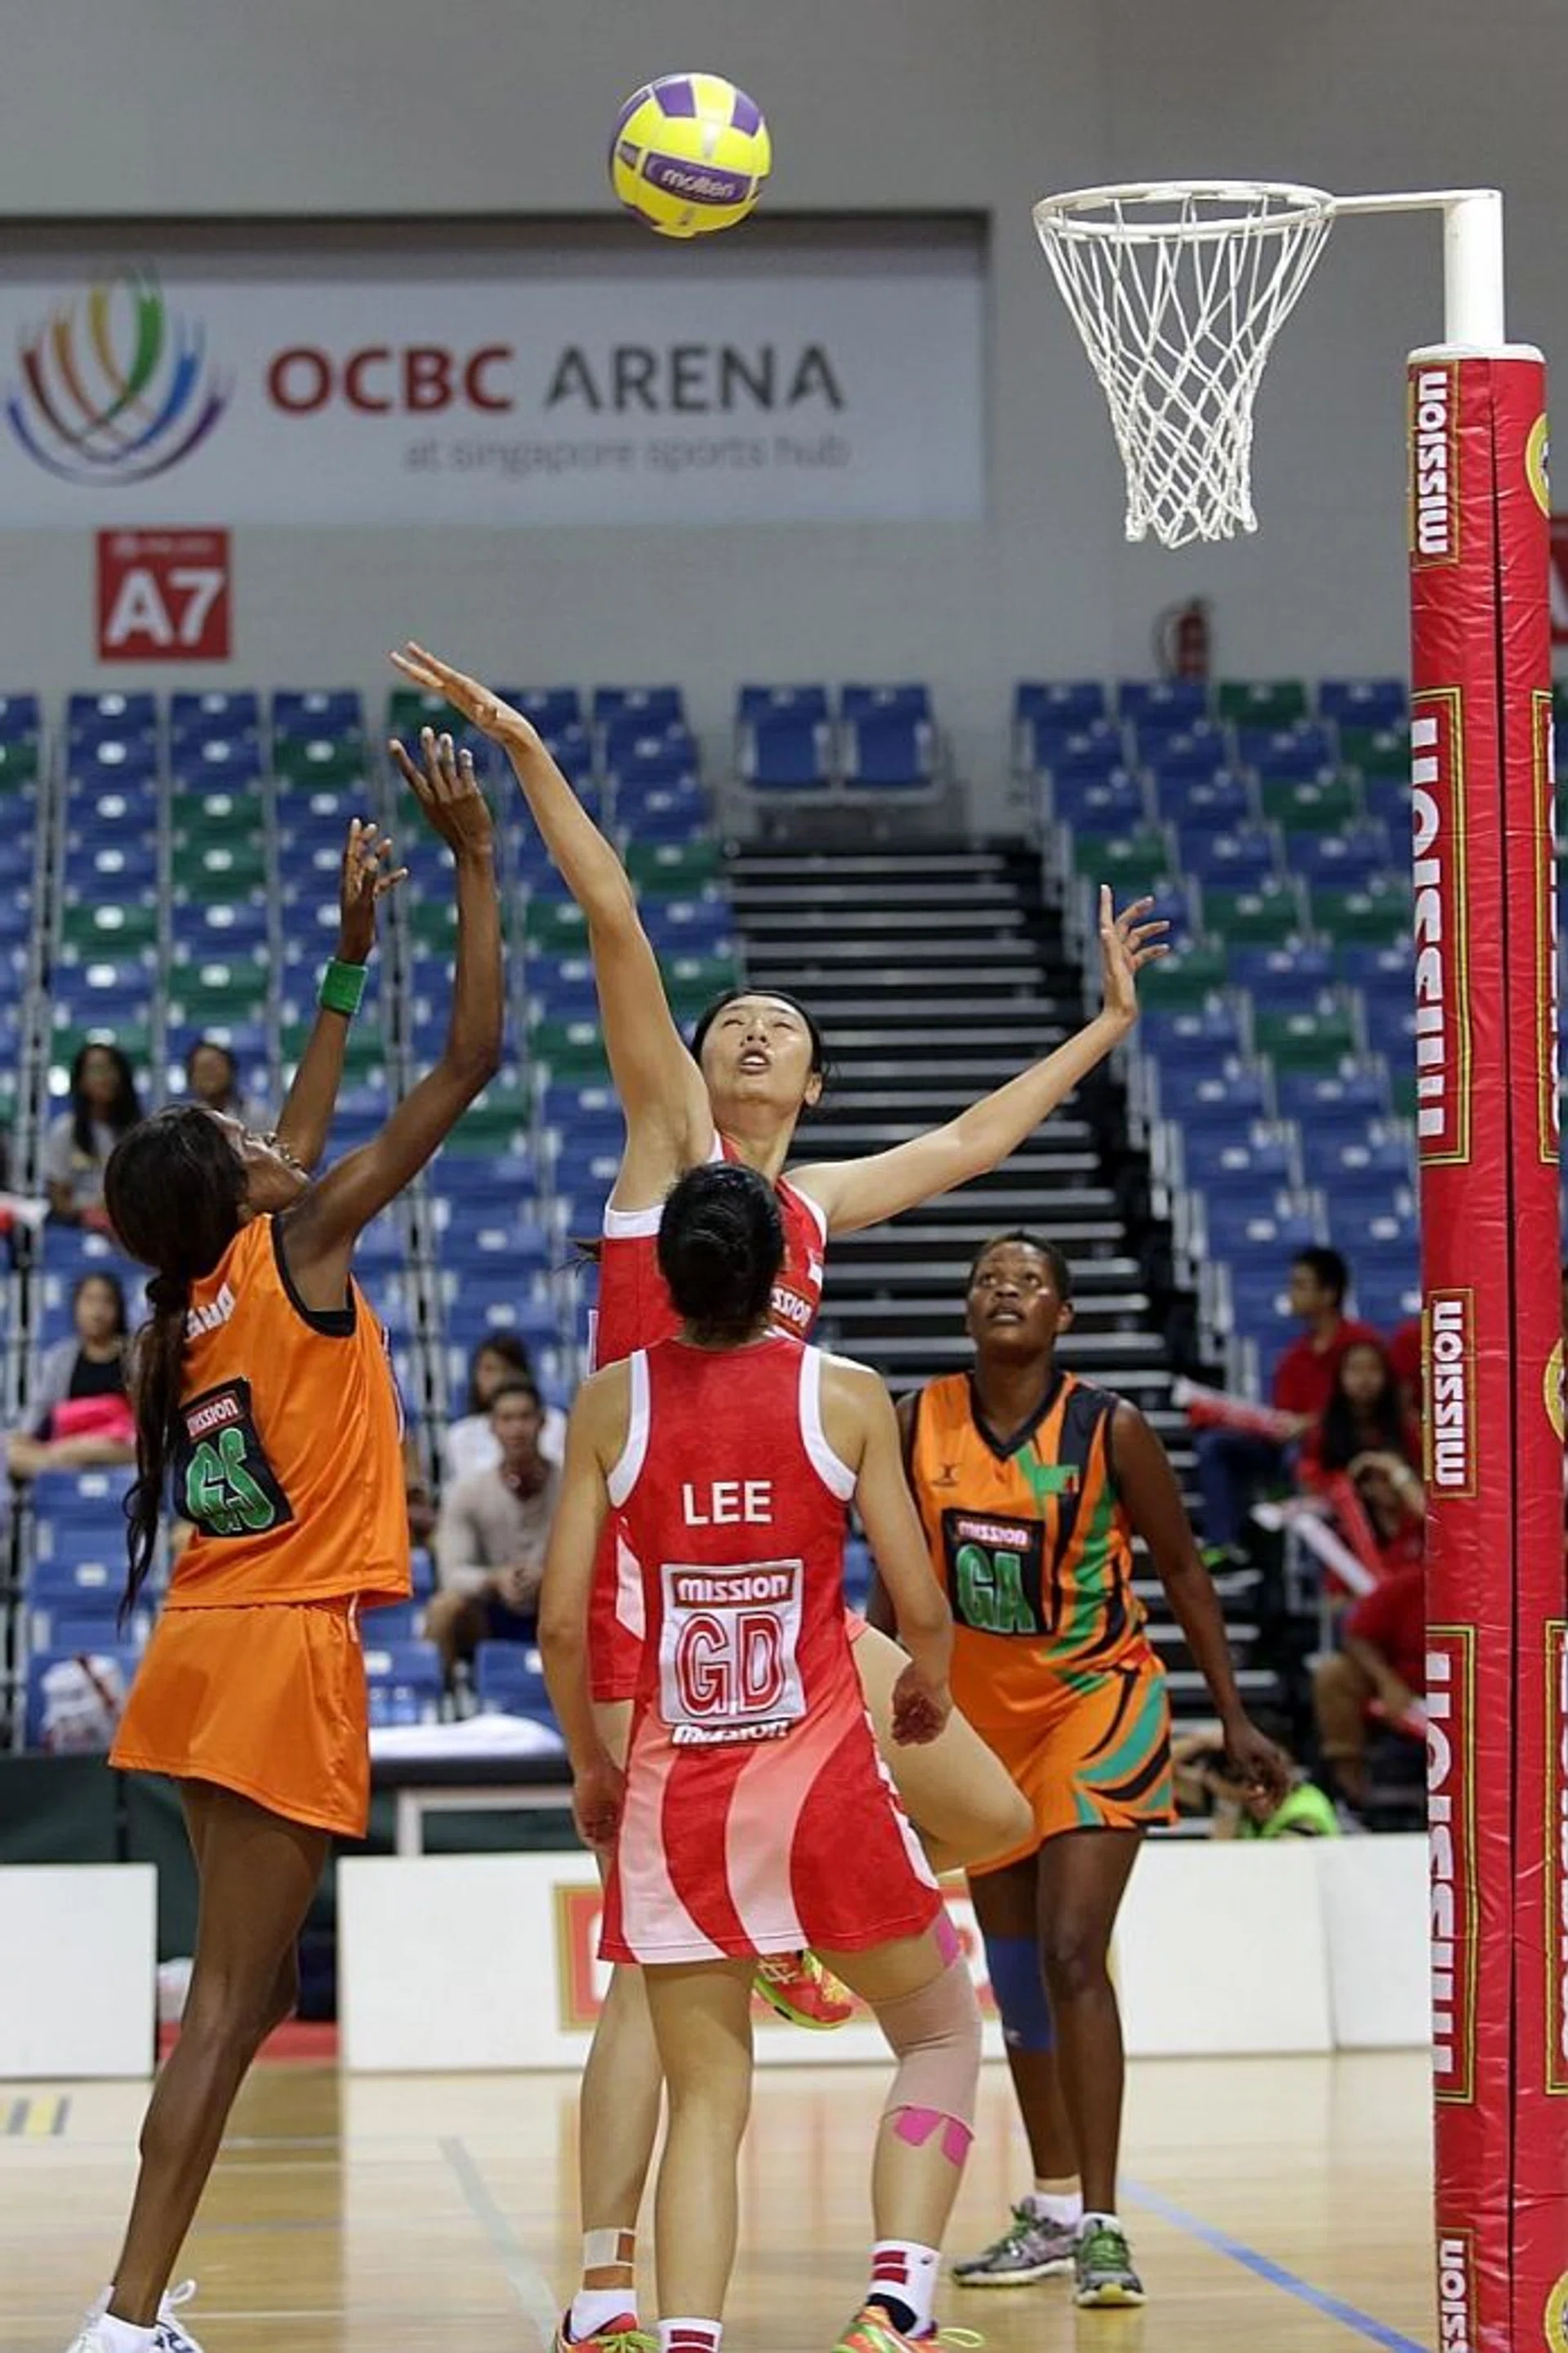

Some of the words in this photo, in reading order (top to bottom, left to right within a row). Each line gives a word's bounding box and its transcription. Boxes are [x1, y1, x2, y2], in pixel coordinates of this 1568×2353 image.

[661, 168, 736, 198] molten
[267, 345, 514, 416] OCBC
[545, 343, 847, 414] ARENA
[773, 432, 852, 470] hub
[105, 566, 223, 648] A7
[185, 1427, 275, 1536] GS
[682, 1480, 773, 1526] LEE
[955, 1544, 1037, 1633] GA
[675, 1611, 786, 1718] GD
